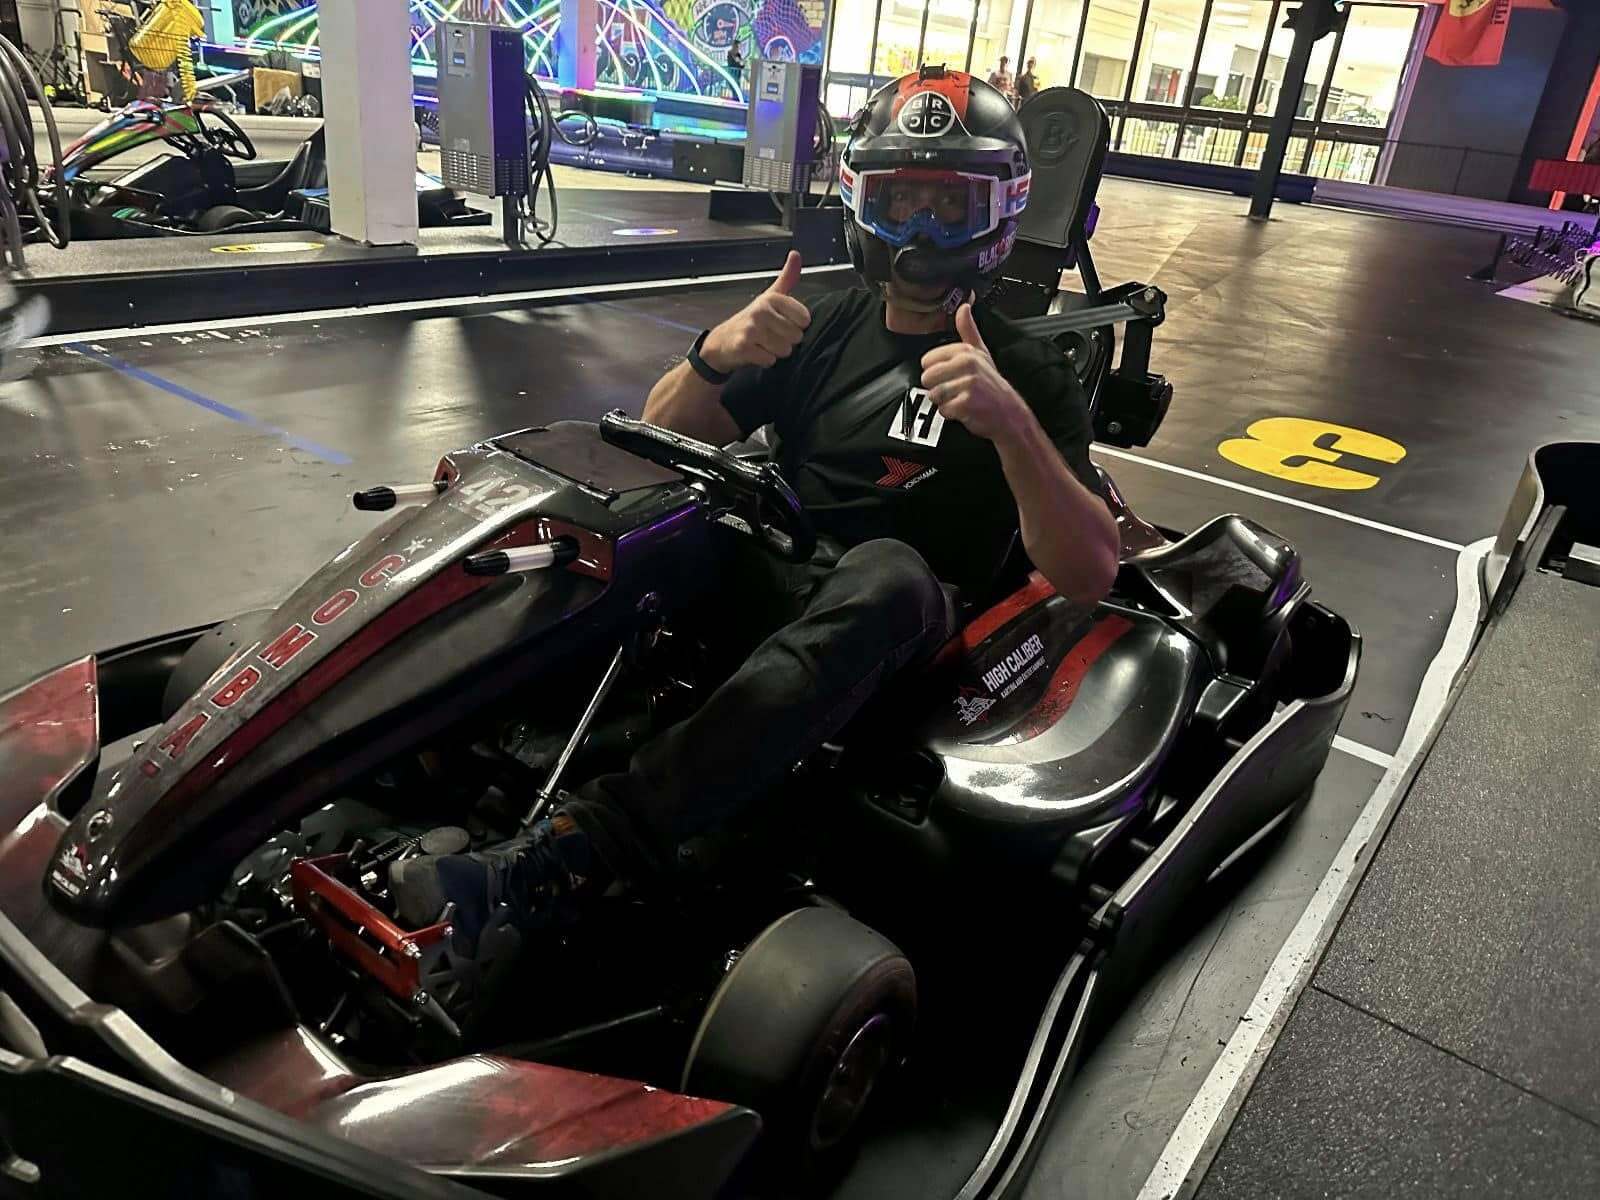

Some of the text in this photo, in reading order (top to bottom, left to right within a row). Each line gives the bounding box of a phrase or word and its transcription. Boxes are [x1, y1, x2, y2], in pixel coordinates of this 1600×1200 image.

[1217, 416, 1407, 490] 3
[458, 475, 530, 515] 42
[141, 553, 407, 778] COMBA
[981, 634, 1044, 693] HIGH CALIBER
